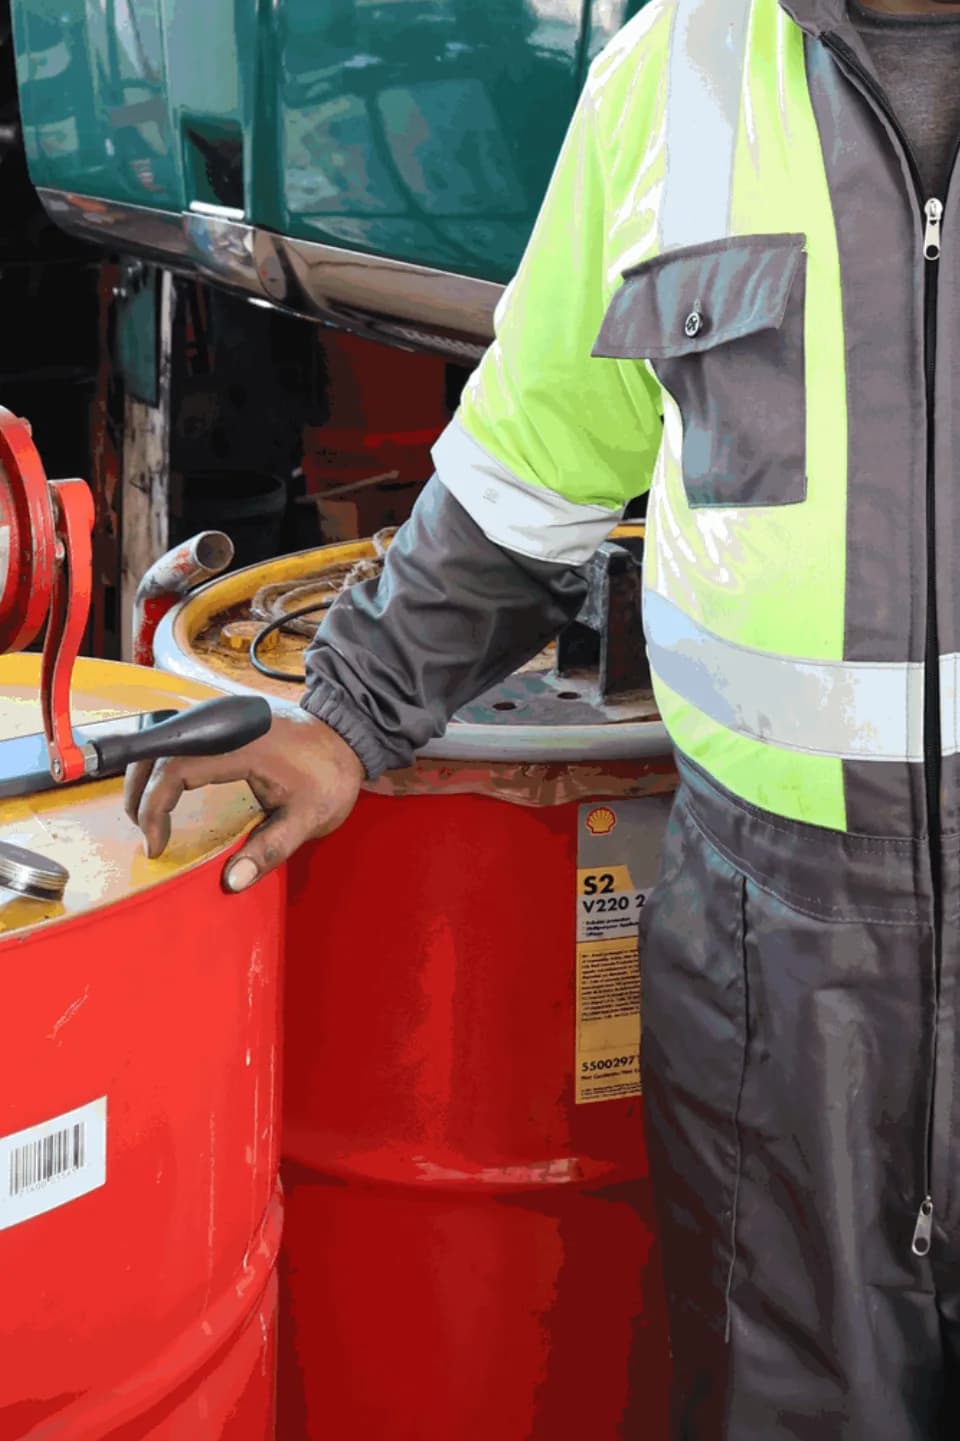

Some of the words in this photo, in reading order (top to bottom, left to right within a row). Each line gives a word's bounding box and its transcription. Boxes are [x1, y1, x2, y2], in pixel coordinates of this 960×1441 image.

[583, 873, 614, 896] S2
[582, 896, 630, 914] V220
[581, 1055, 640, 1072] 5500297
